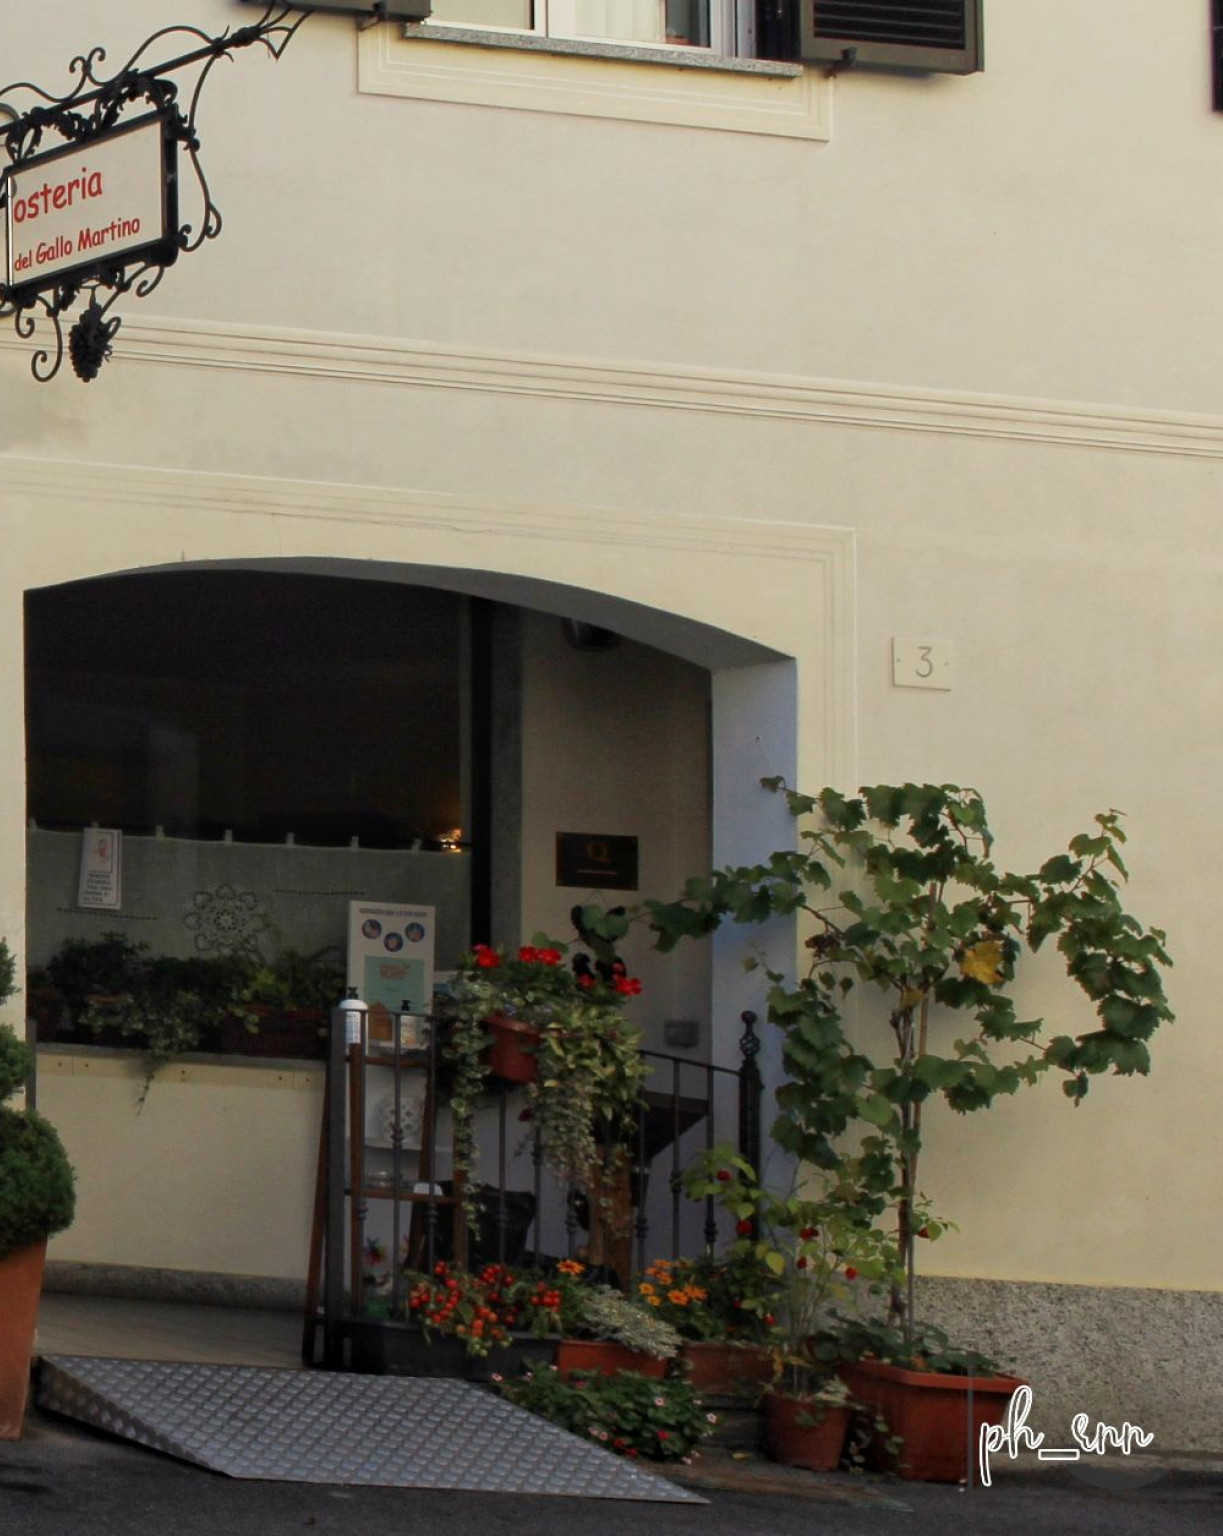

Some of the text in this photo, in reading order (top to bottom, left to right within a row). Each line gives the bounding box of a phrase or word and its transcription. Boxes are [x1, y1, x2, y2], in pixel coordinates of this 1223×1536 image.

[13, 167, 103, 222] osteria
[13, 217, 140, 272] del Gallo Martino
[916, 646, 933, 678] 3
